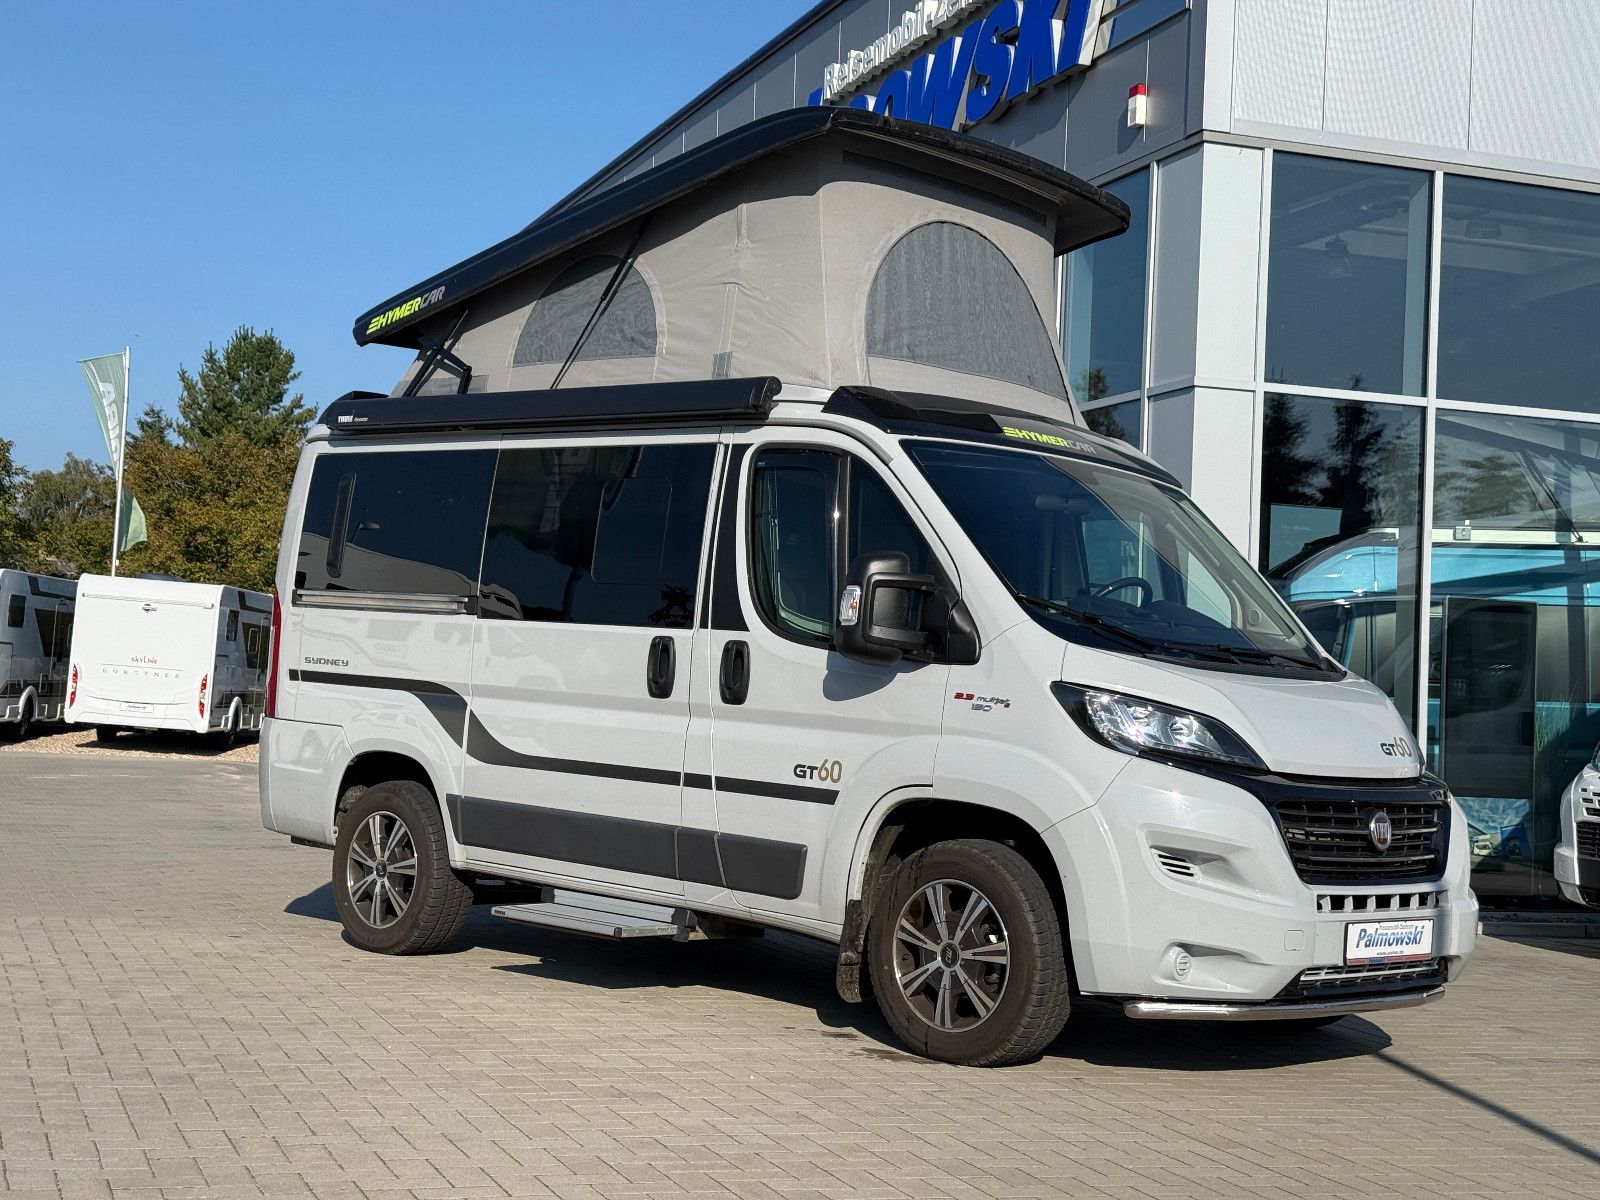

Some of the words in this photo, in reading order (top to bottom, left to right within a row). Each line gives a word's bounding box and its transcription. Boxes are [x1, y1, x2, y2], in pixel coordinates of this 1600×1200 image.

[304, 656, 349, 667] SYDNEY
[1380, 736, 1412, 757] GT60
[793, 758, 842, 784] GT60
[1356, 925, 1425, 949] Palmowski
